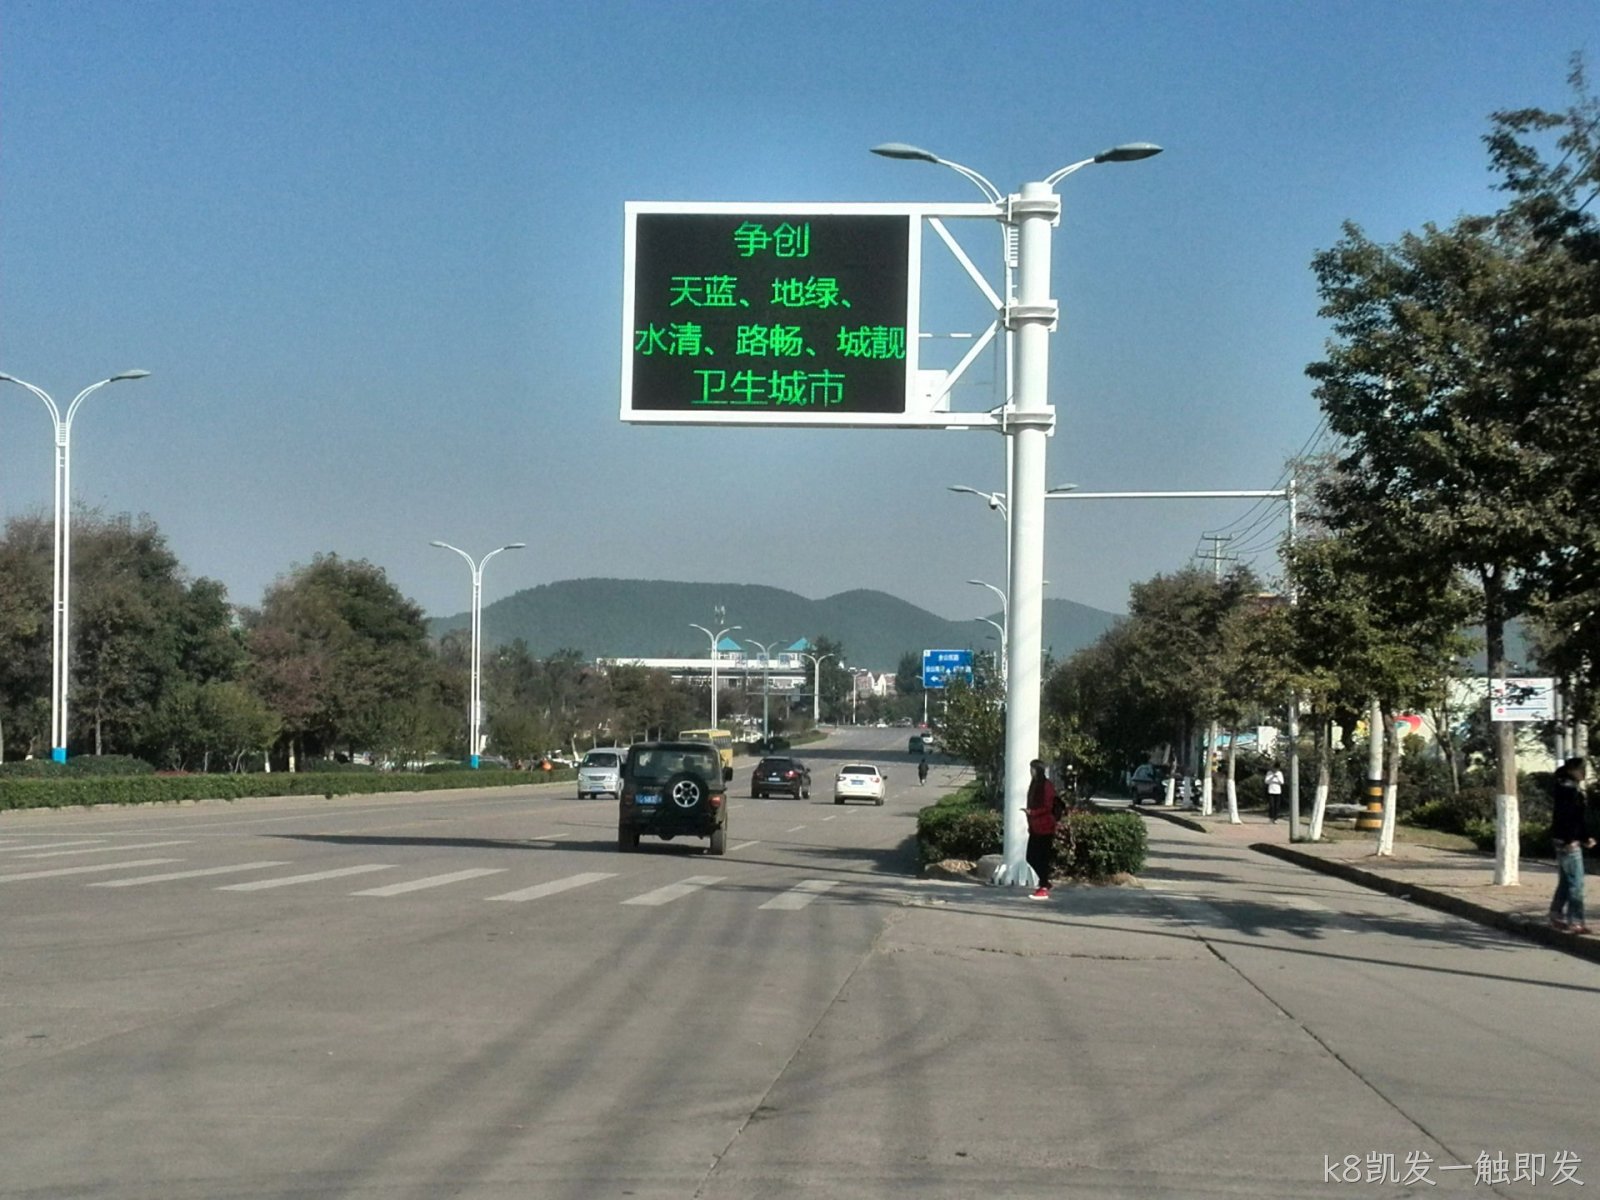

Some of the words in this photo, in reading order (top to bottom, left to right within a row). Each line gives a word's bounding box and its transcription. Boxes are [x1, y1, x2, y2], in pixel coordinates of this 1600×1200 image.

[734, 220, 811, 258] 争创
[691, 368, 846, 407] 卫生城市
